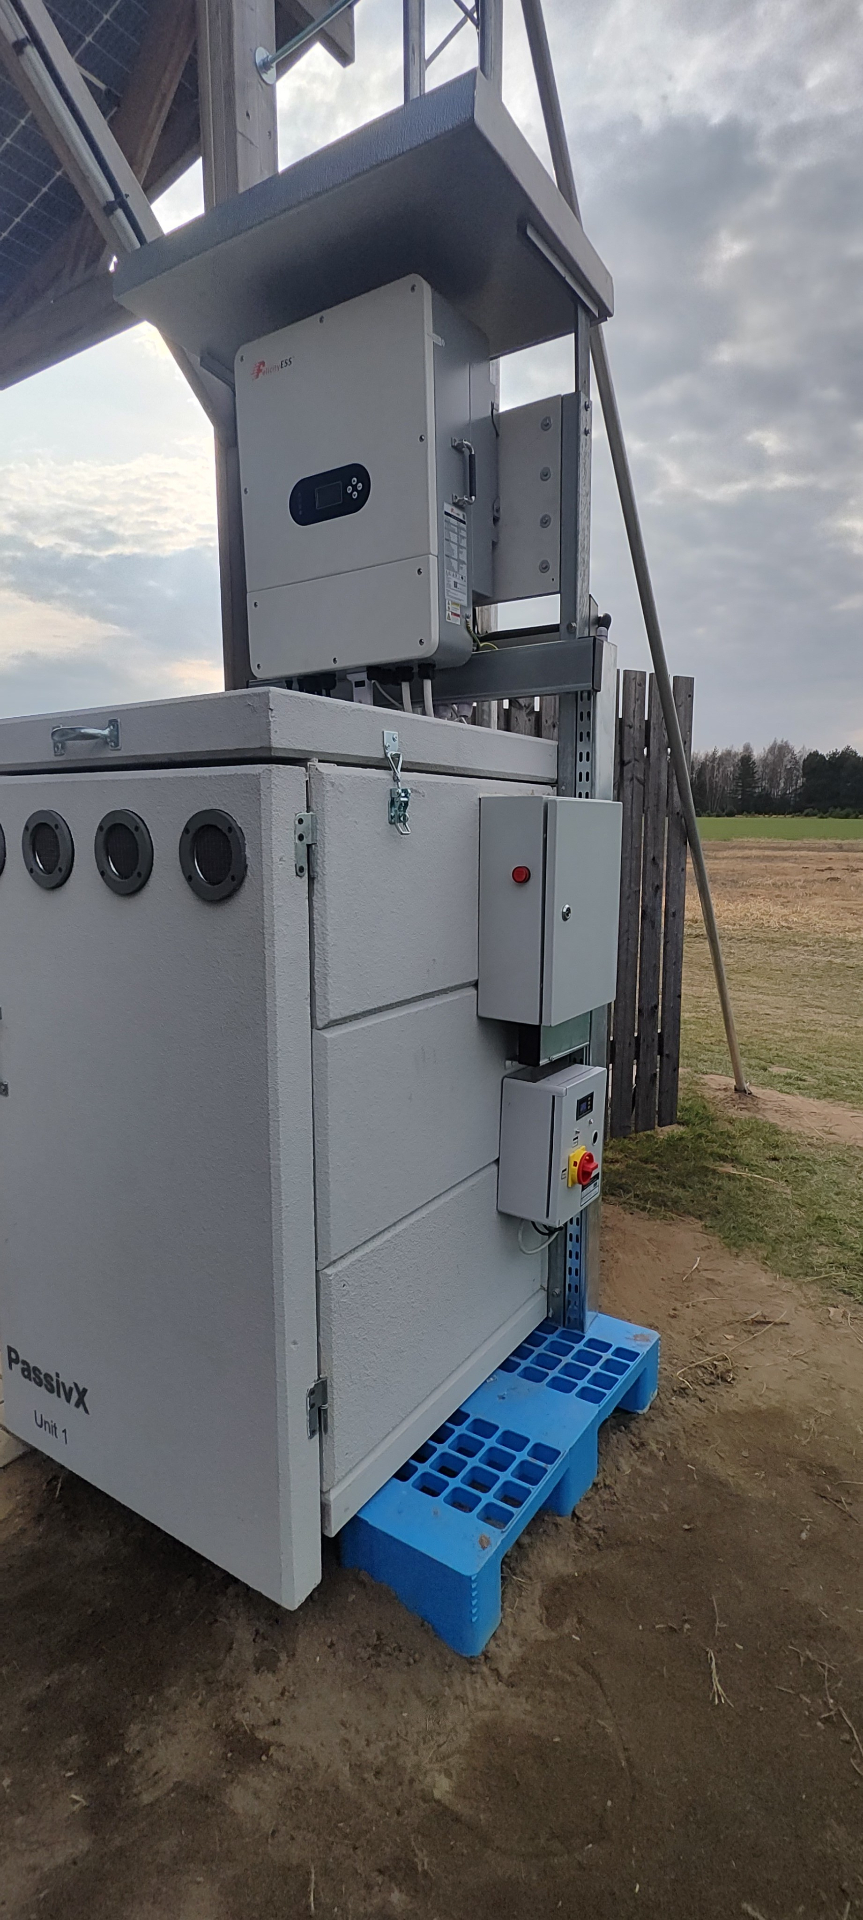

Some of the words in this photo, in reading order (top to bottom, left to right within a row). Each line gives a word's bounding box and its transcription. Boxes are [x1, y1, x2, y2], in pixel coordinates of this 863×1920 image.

[7, 1345, 90, 1415] PassivX
[34, 1410, 58, 1439] Unit
[62, 1428, 68, 1445] 1
